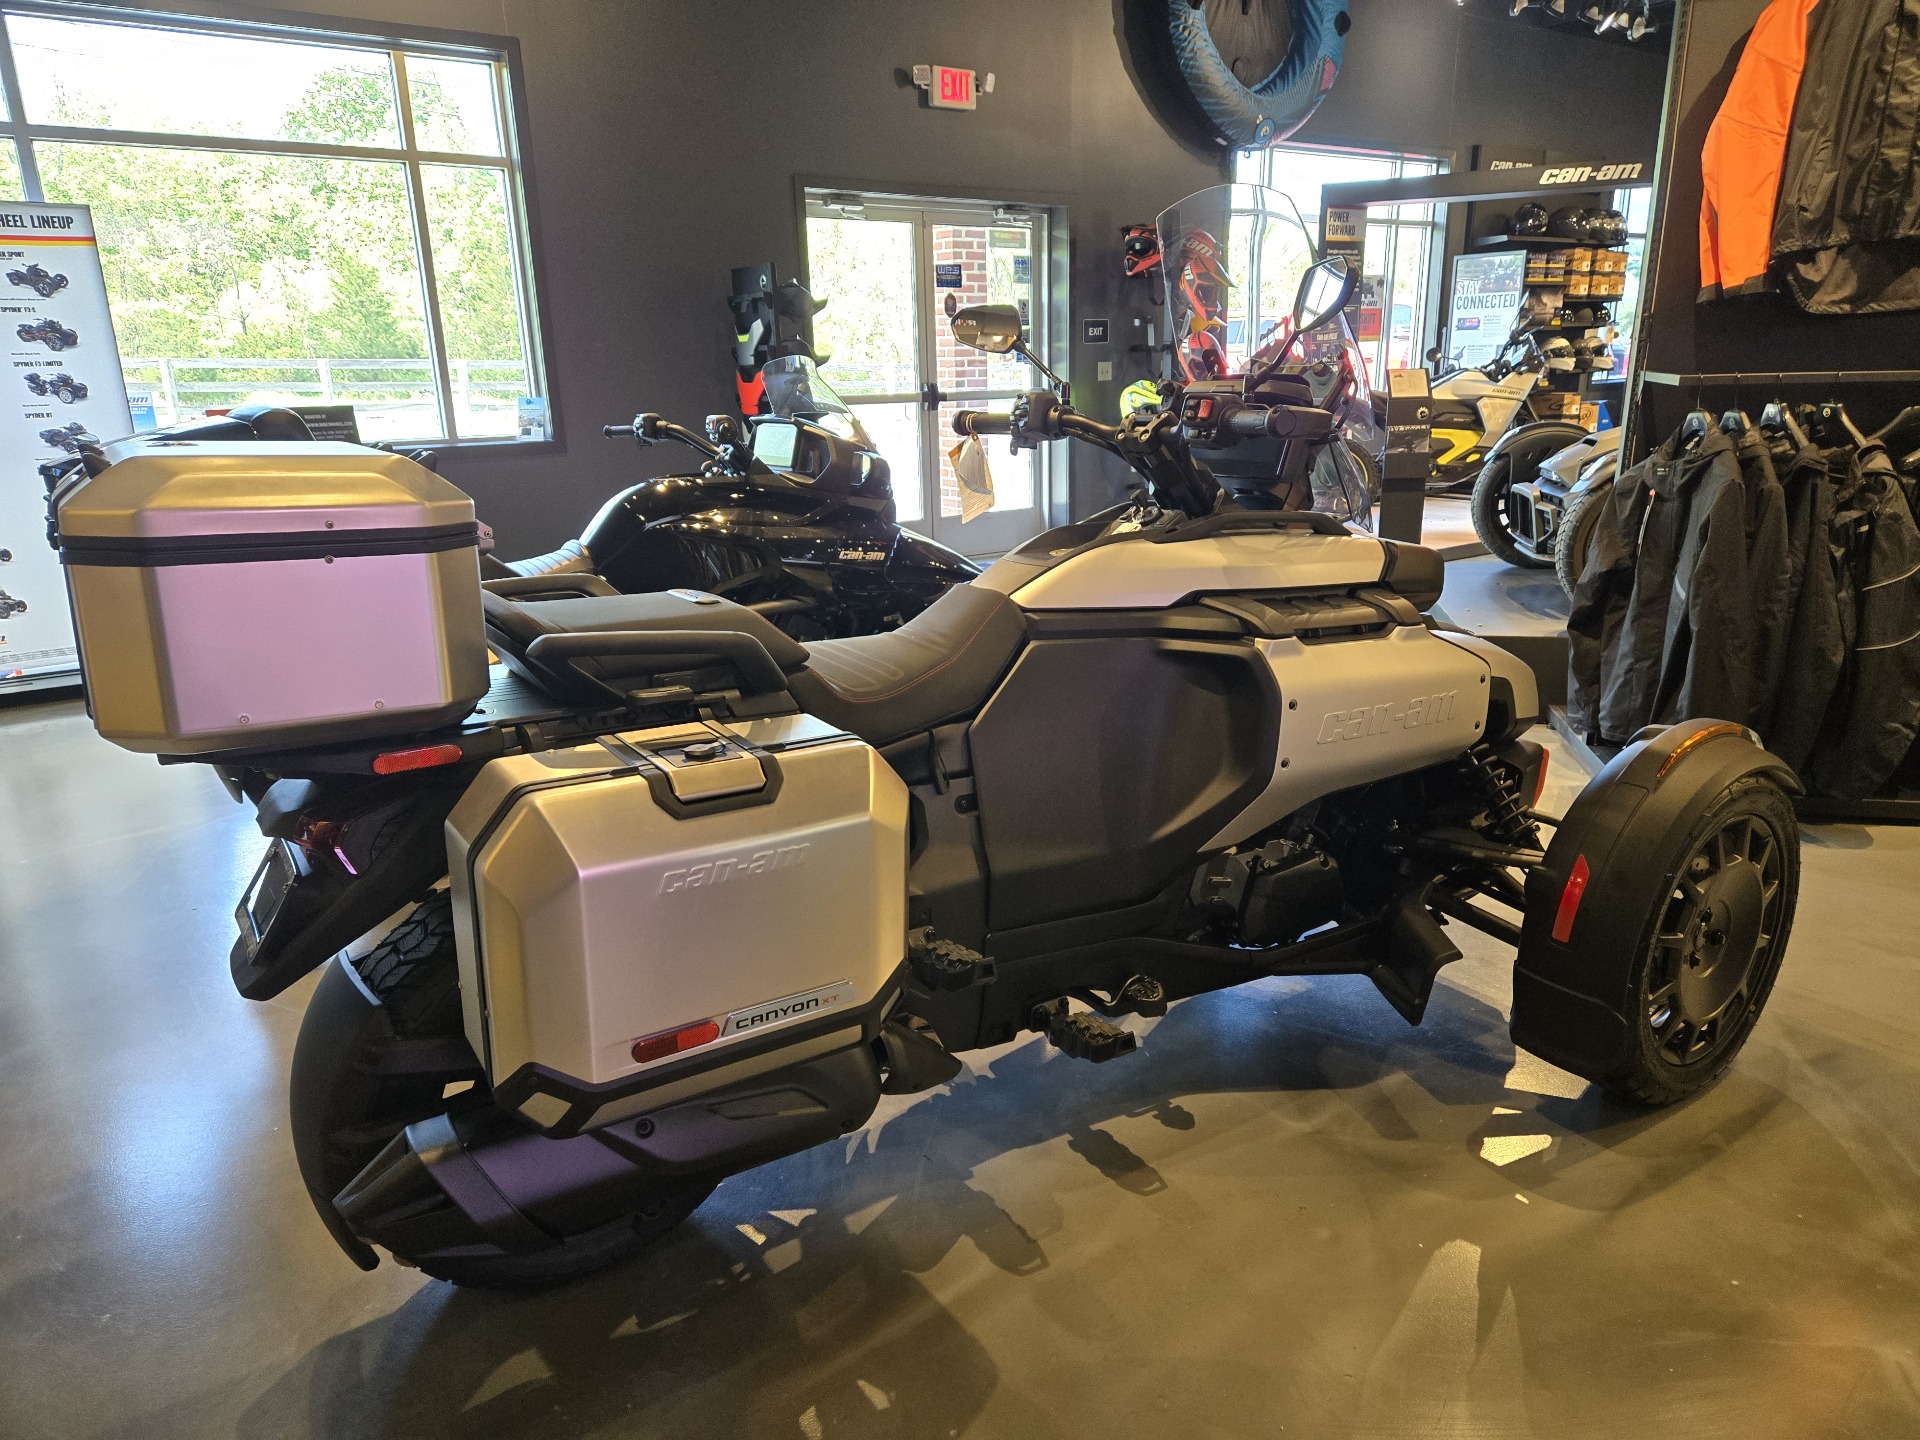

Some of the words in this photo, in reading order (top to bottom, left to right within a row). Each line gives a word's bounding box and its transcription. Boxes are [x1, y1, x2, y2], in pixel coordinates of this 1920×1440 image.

[940, 67, 971, 104] EXIT
[1538, 162, 1643, 185] can-am
[29, 214, 74, 229] LINEUP
[1329, 211, 1352, 223] POWER-
[1328, 224, 1356, 236] FORWARD
[1456, 280, 1482, 296] STAY
[1456, 293, 1516, 310] CONNECTED
[1088, 326, 1104, 336] EXIT
[838, 550, 886, 561] can-am
[1316, 689, 1458, 745] can-am
[656, 843, 810, 897] can-am
[735, 997, 819, 1030] CANYON
[821, 994, 840, 1005] XT
